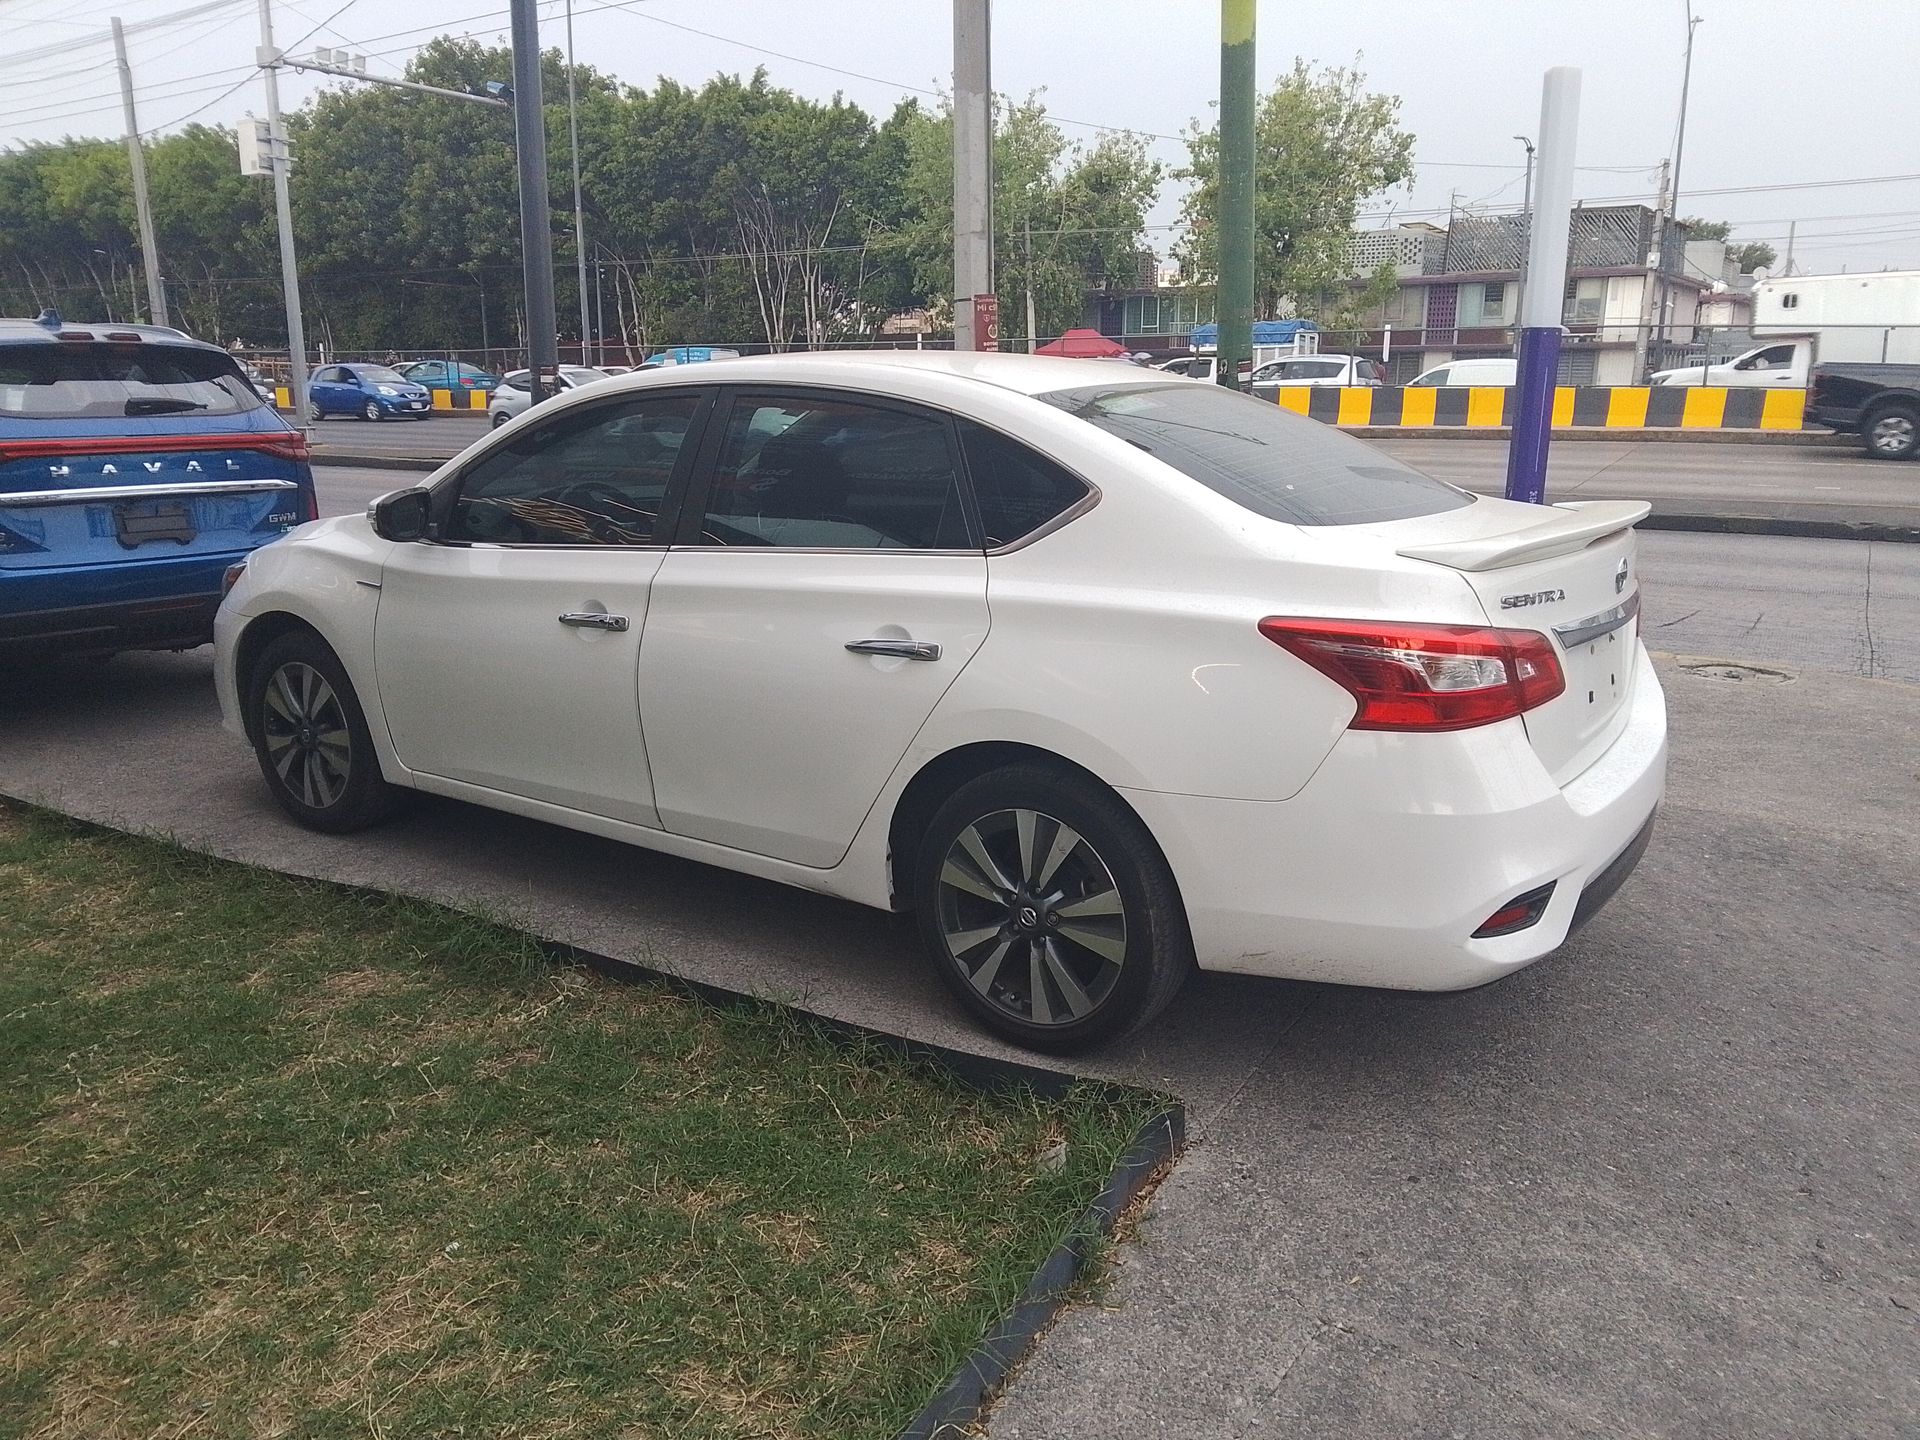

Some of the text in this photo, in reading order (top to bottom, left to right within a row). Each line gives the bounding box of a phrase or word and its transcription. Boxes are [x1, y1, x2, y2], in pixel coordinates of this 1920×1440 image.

[50, 459, 240, 476] HAVAL
[269, 511, 297, 523] GWM
[1500, 589, 1566, 610] SENTRA
